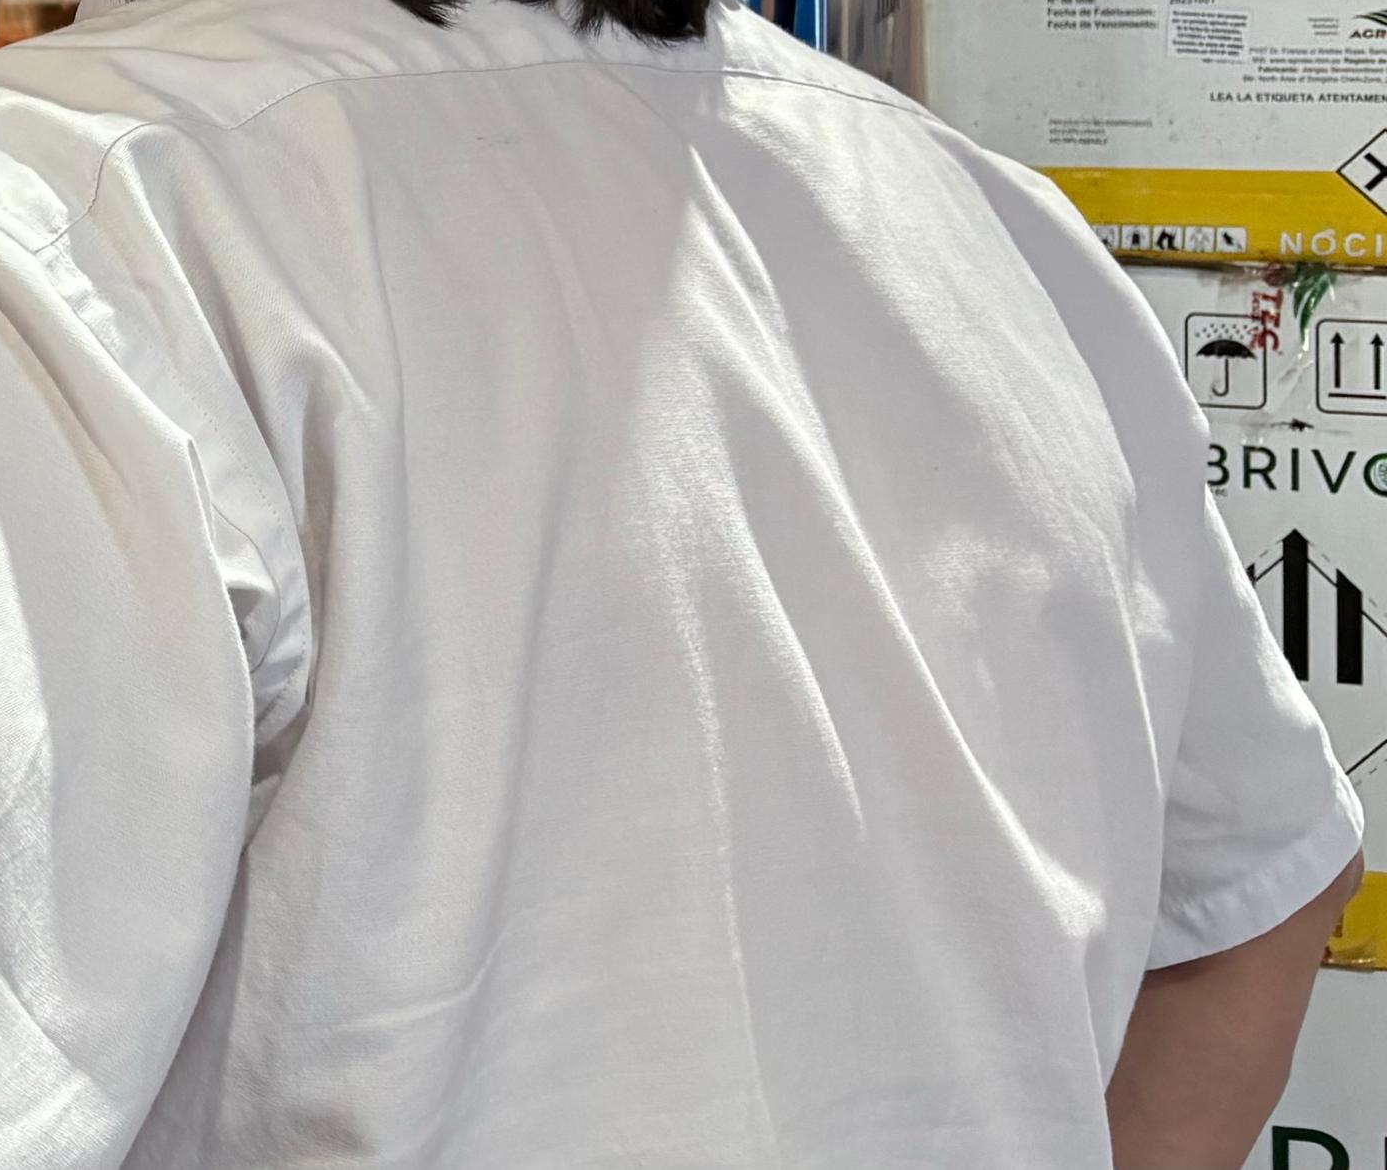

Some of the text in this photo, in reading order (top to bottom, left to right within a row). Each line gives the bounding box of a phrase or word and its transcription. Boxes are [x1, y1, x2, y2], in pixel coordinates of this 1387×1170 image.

[1210, 92, 1234, 102] LEA
[1236, 92, 1253, 102] LA
[1256, 92, 1314, 103] ETIQUETA
